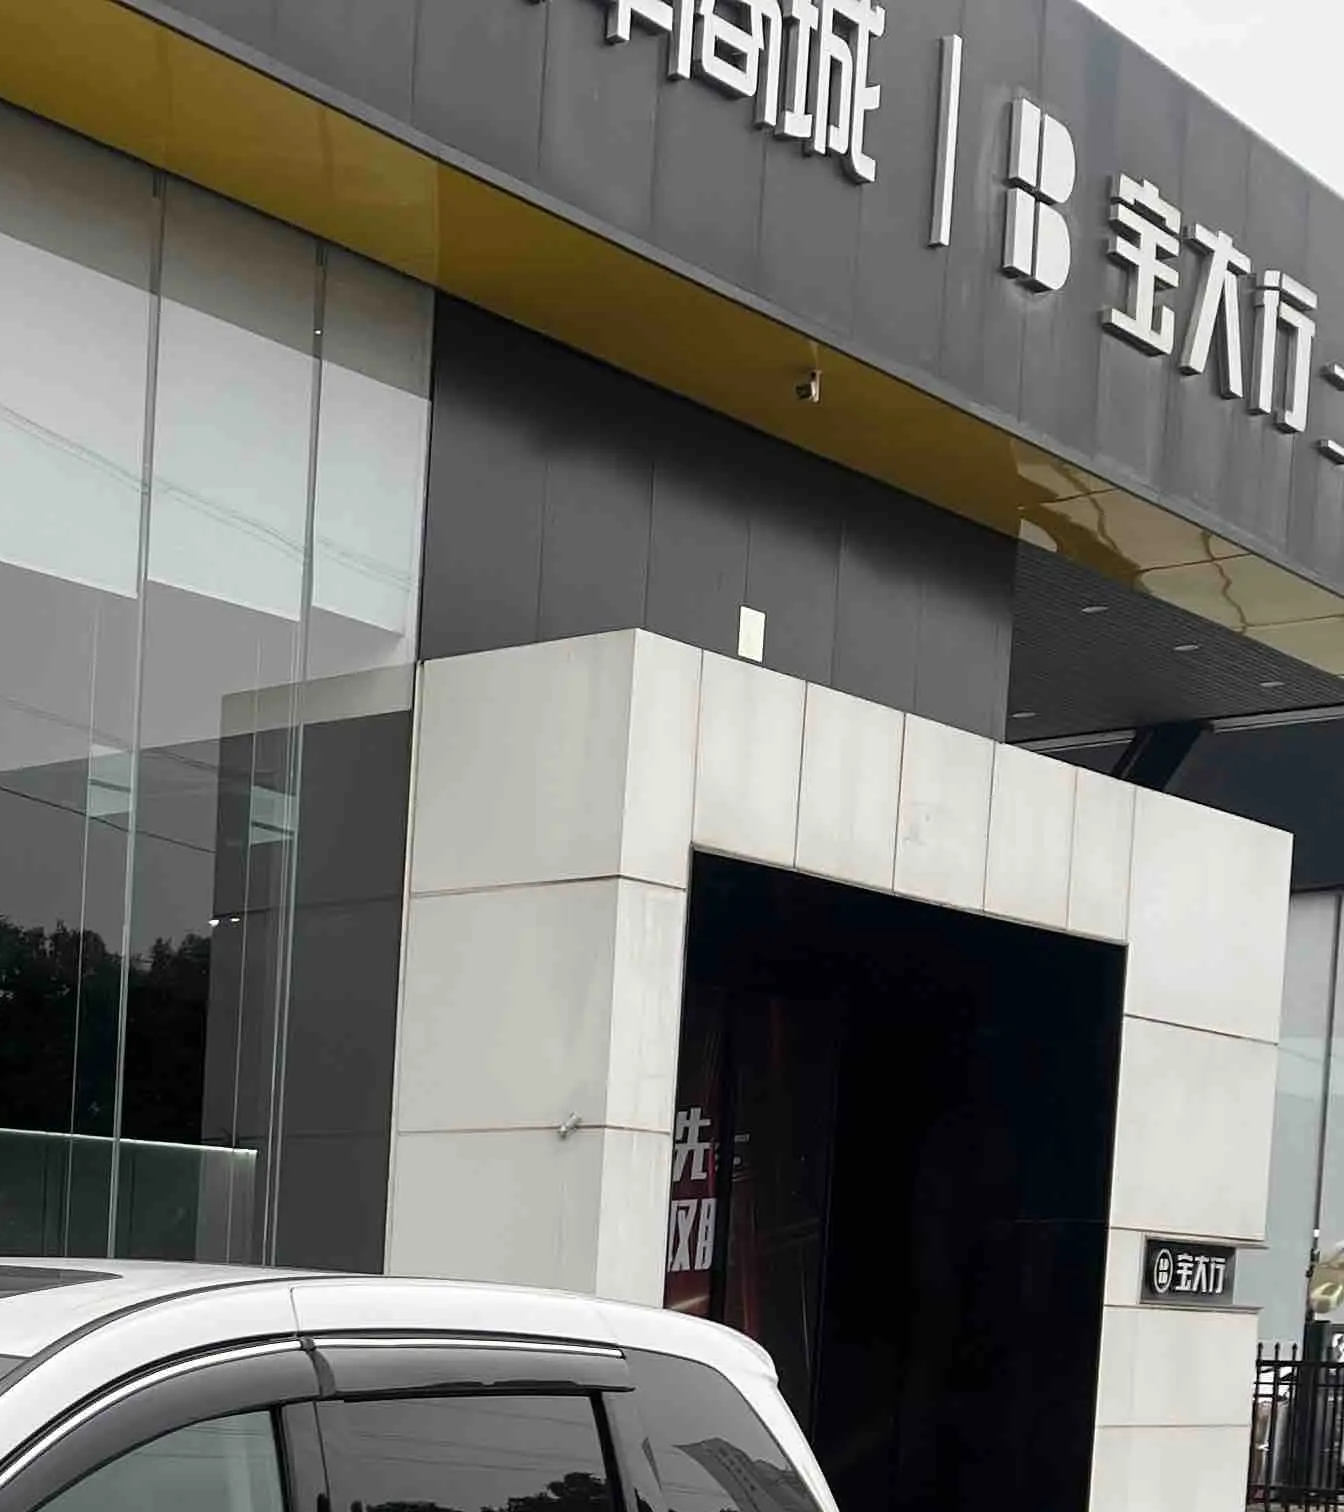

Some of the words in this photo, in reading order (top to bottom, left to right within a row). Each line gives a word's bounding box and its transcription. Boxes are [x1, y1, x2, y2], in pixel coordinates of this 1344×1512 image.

[1102, 170, 1318, 433] 宝大行
[1175, 1252, 1226, 1295] 宝大行
